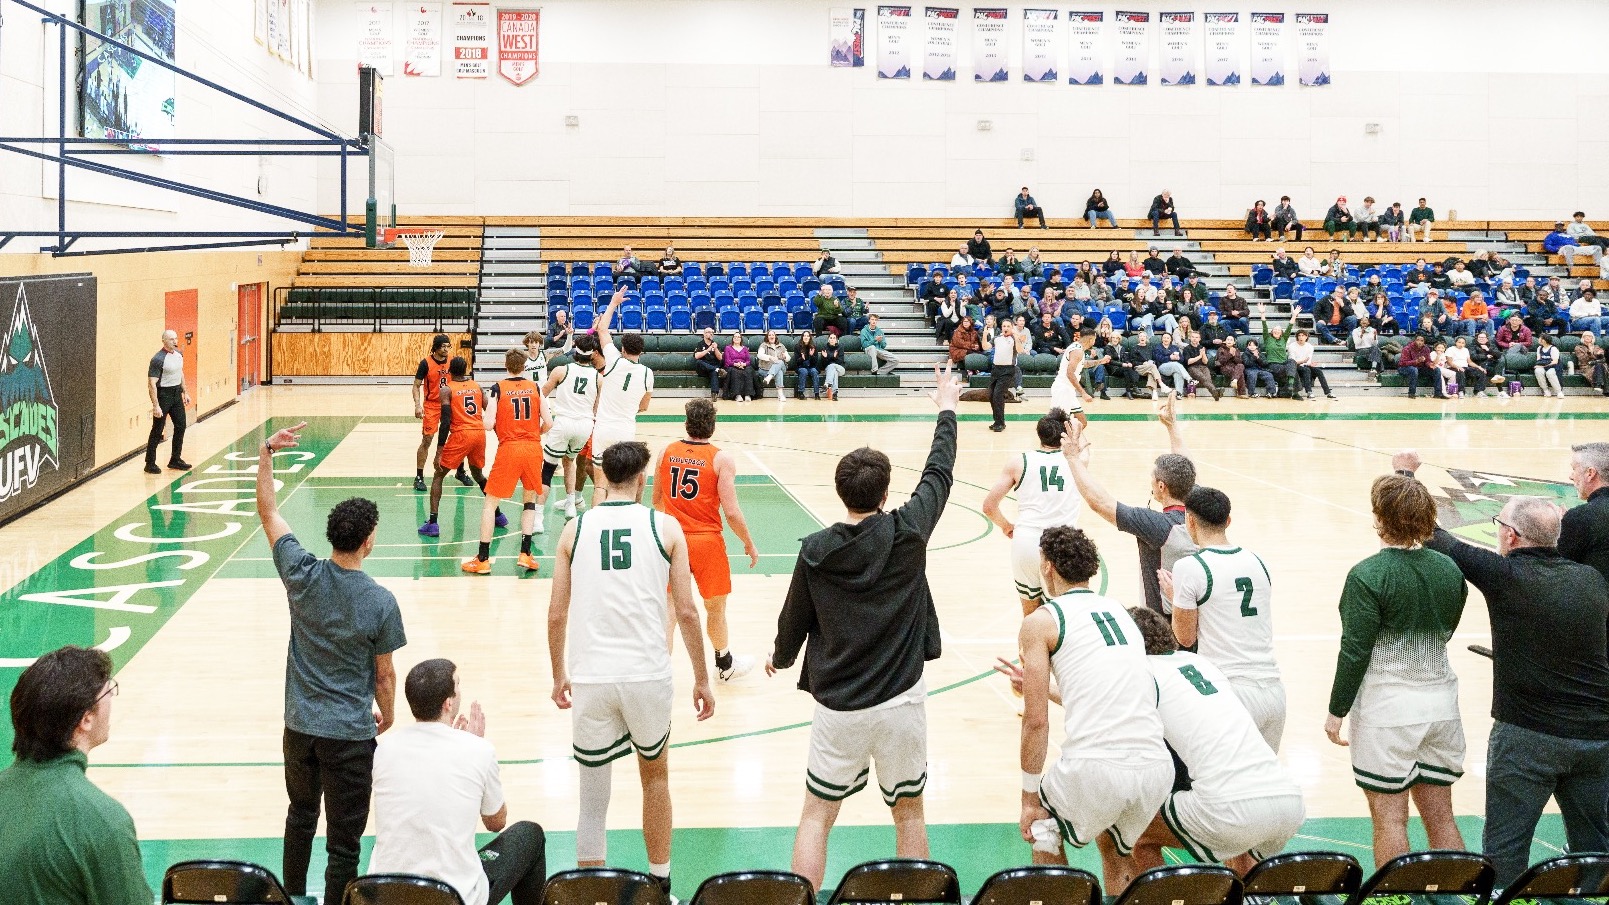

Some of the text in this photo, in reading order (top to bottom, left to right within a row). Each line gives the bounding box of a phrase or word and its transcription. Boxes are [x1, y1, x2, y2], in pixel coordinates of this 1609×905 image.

[502, 22, 535, 33] CANADA
[502, 34, 535, 49] WEST
[460, 48, 482, 59] 2018
[573, 376, 589, 395] 12
[622, 373, 632, 391] 1
[464, 396, 477, 416] 5
[511, 397, 531, 420] 11
[0, 443, 41, 497] UFV
[669, 456, 706, 467] WOLFPACK
[670, 466, 699, 500] 15
[1039, 465, 1065, 492] 14
[600, 528, 632, 571] 15
[1234, 576, 1258, 618] 2
[1090, 611, 1128, 646] 11
[1177, 664, 1218, 696] 8
